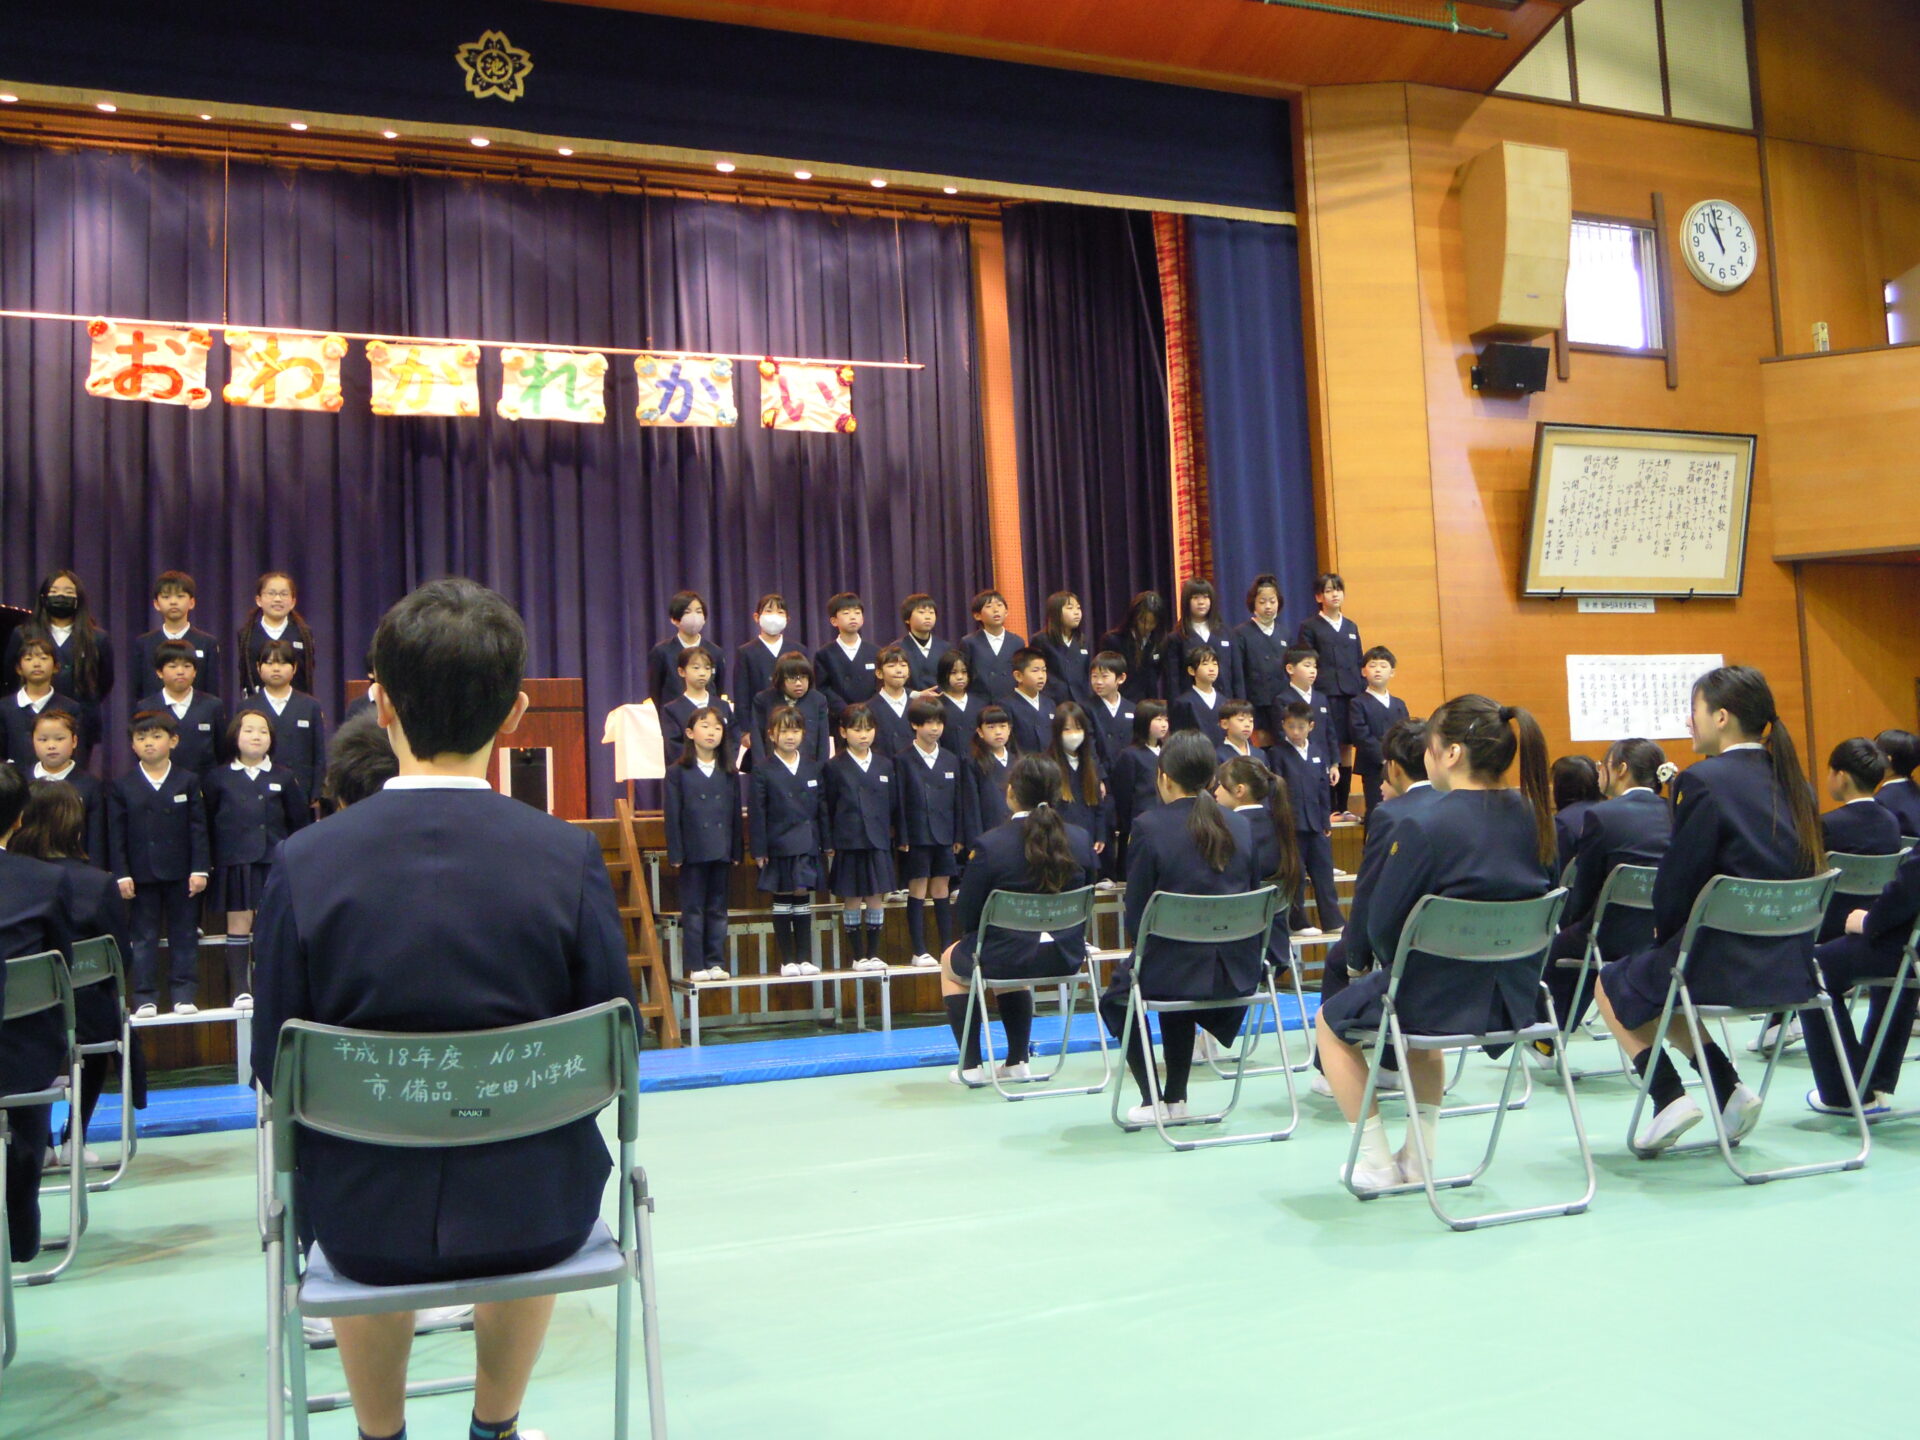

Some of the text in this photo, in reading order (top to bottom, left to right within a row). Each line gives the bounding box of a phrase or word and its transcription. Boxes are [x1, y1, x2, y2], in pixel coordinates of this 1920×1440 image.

[1728, 215, 1732, 227] 1
[1694, 222, 1705, 234] 10
[1735, 226, 1742, 237] 2
[1692, 236, 1700, 247] 9
[1740, 241, 1747, 253] 3
[1698, 251, 1705, 262] 8
[1737, 256, 1744, 266] 4
[1708, 262, 1715, 274] 7
[1719, 267, 1726, 279] 6
[1730, 265, 1737, 276] 5
[113, 330, 836, 422] おわかれかい
[475, 1054, 587, 1099] 池田小学校
